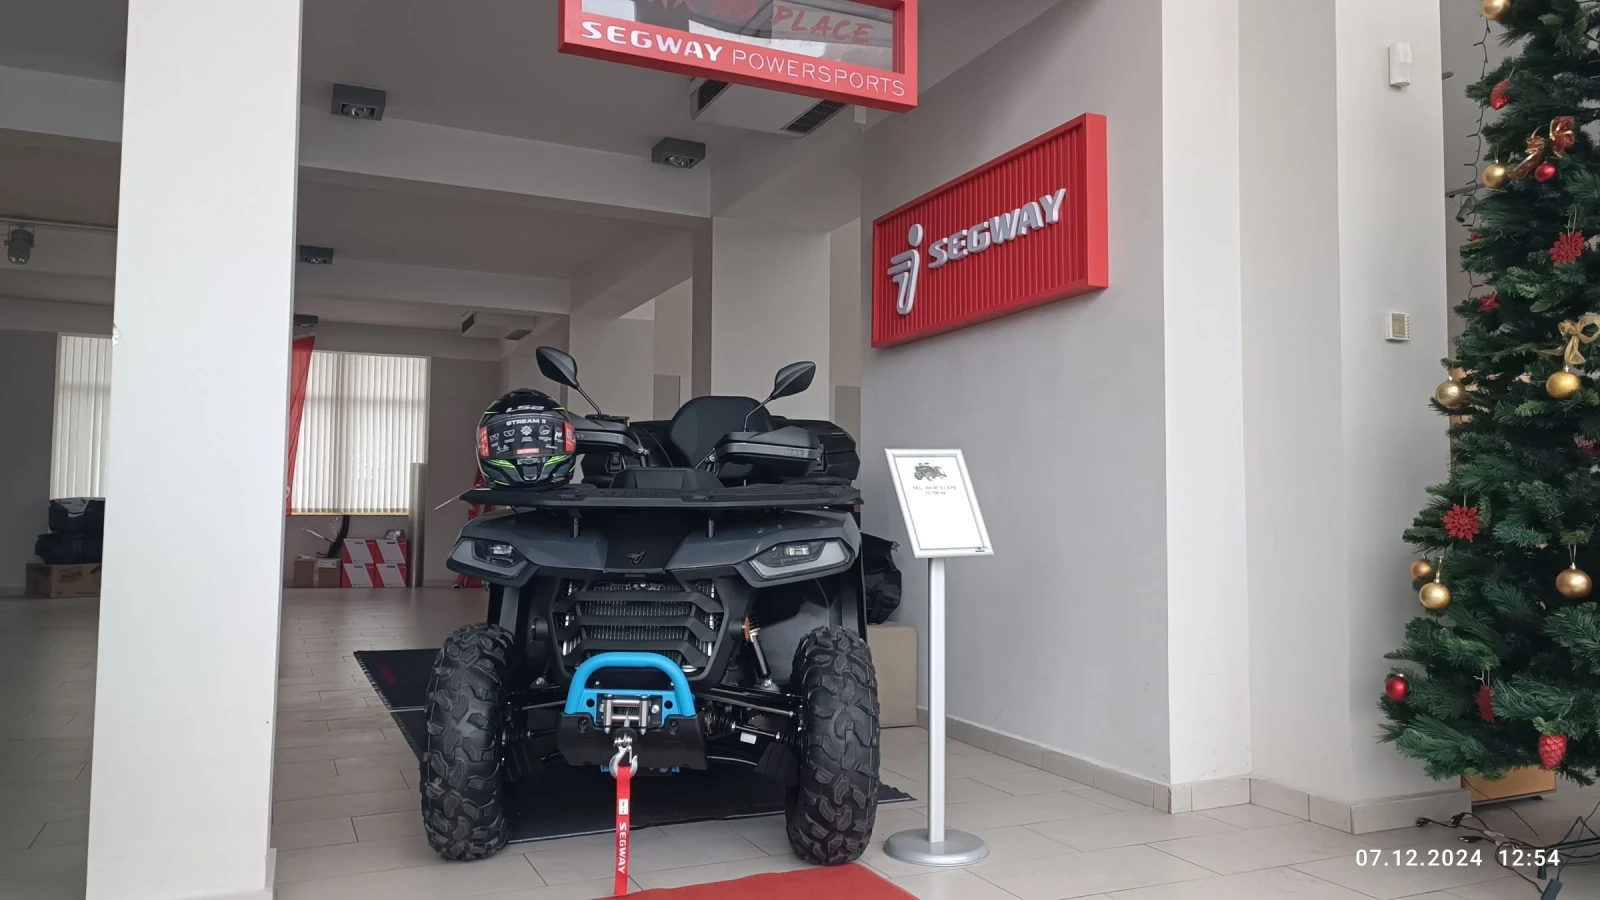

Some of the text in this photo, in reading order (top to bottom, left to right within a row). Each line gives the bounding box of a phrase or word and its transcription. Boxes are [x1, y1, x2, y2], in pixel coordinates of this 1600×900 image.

[773, 5, 875, 45] PLACE
[581, 20, 906, 97] SEGWAY POWERSPORTS
[928, 188, 1066, 269] SEGWAY
[505, 418, 540, 426] STREAM
[617, 822, 627, 875] SEGWAY
